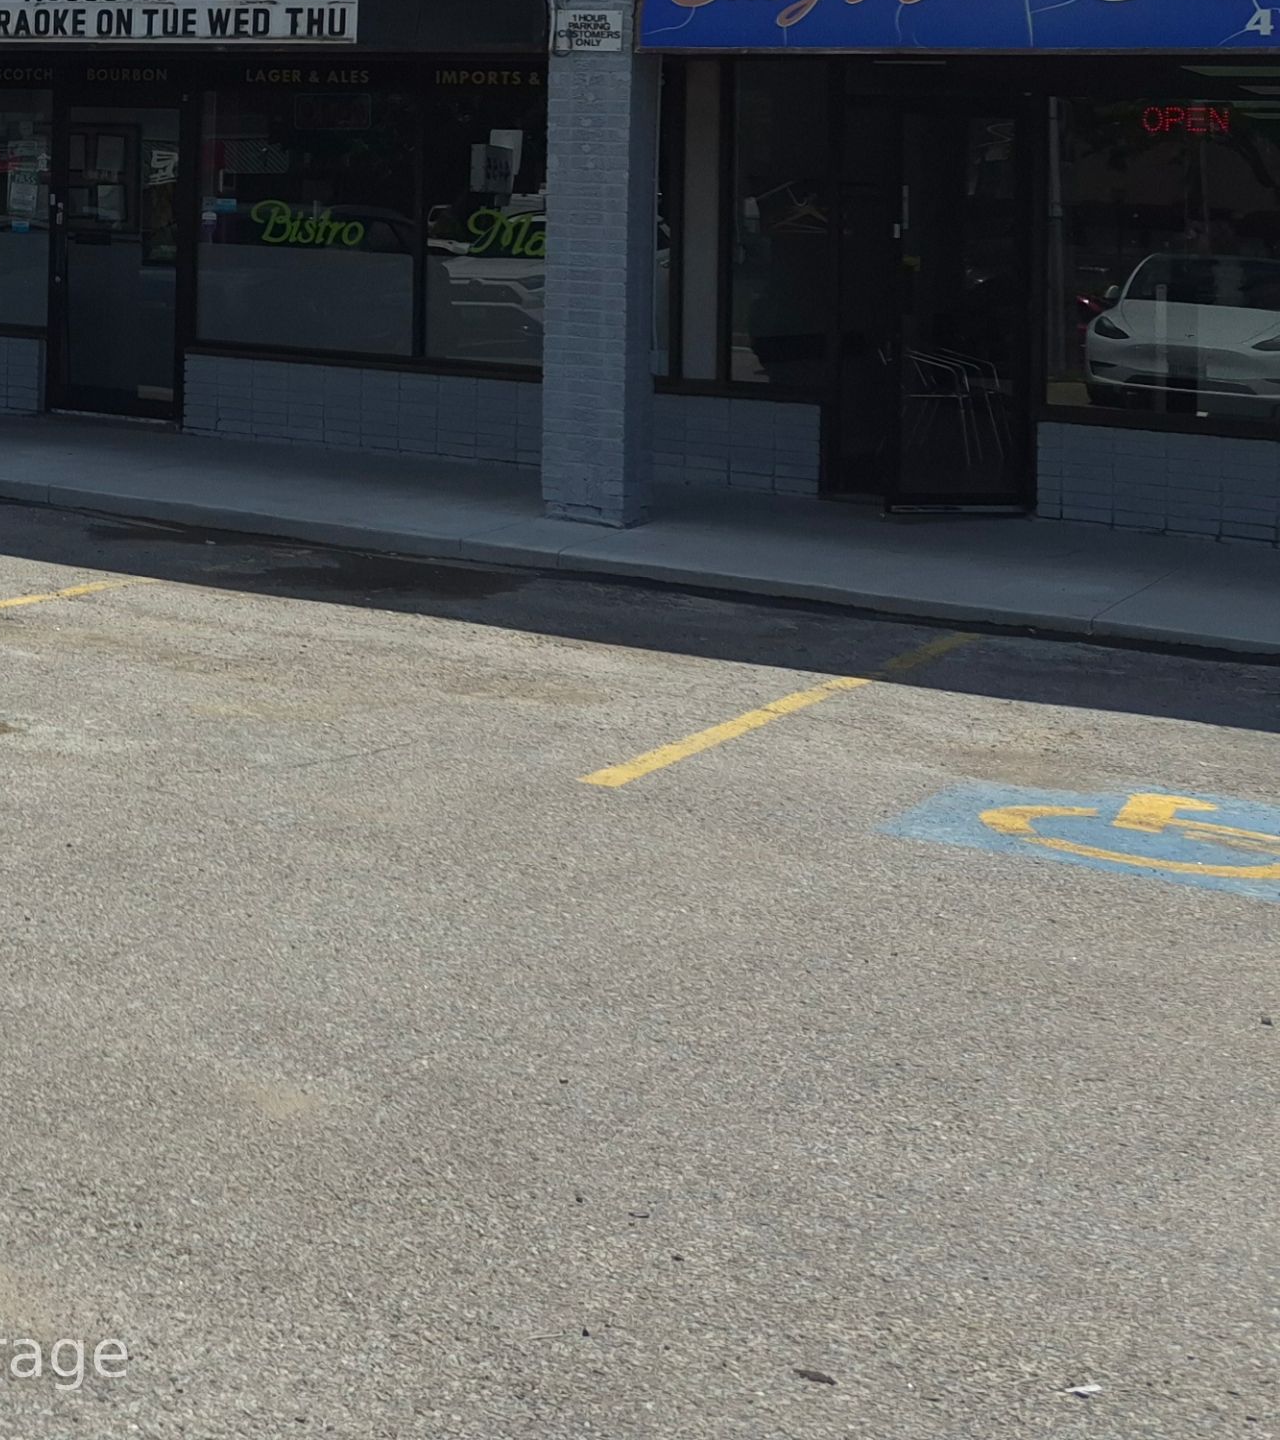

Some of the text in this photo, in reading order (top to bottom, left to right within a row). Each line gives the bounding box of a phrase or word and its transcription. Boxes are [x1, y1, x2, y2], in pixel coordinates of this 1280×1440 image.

[96, 8, 133, 36] ON
[142, 8, 197, 37] TUE
[207, 8, 271, 36] WED
[285, 7, 347, 37] THU
[568, 22, 611, 31] PARKING
[578, 14, 608, 22] HOUR
[575, 38, 601, 47] ONLY
[86, 68, 169, 82] BOURBON
[245, 68, 302, 84] LAGER
[307, 70, 320, 84] &
[327, 70, 370, 85] ALES
[435, 70, 522, 86] IMPORTS
[528, 72, 541, 86] &
[1142, 106, 1231, 133] OPEN
[250, 199, 366, 247] Bistro
